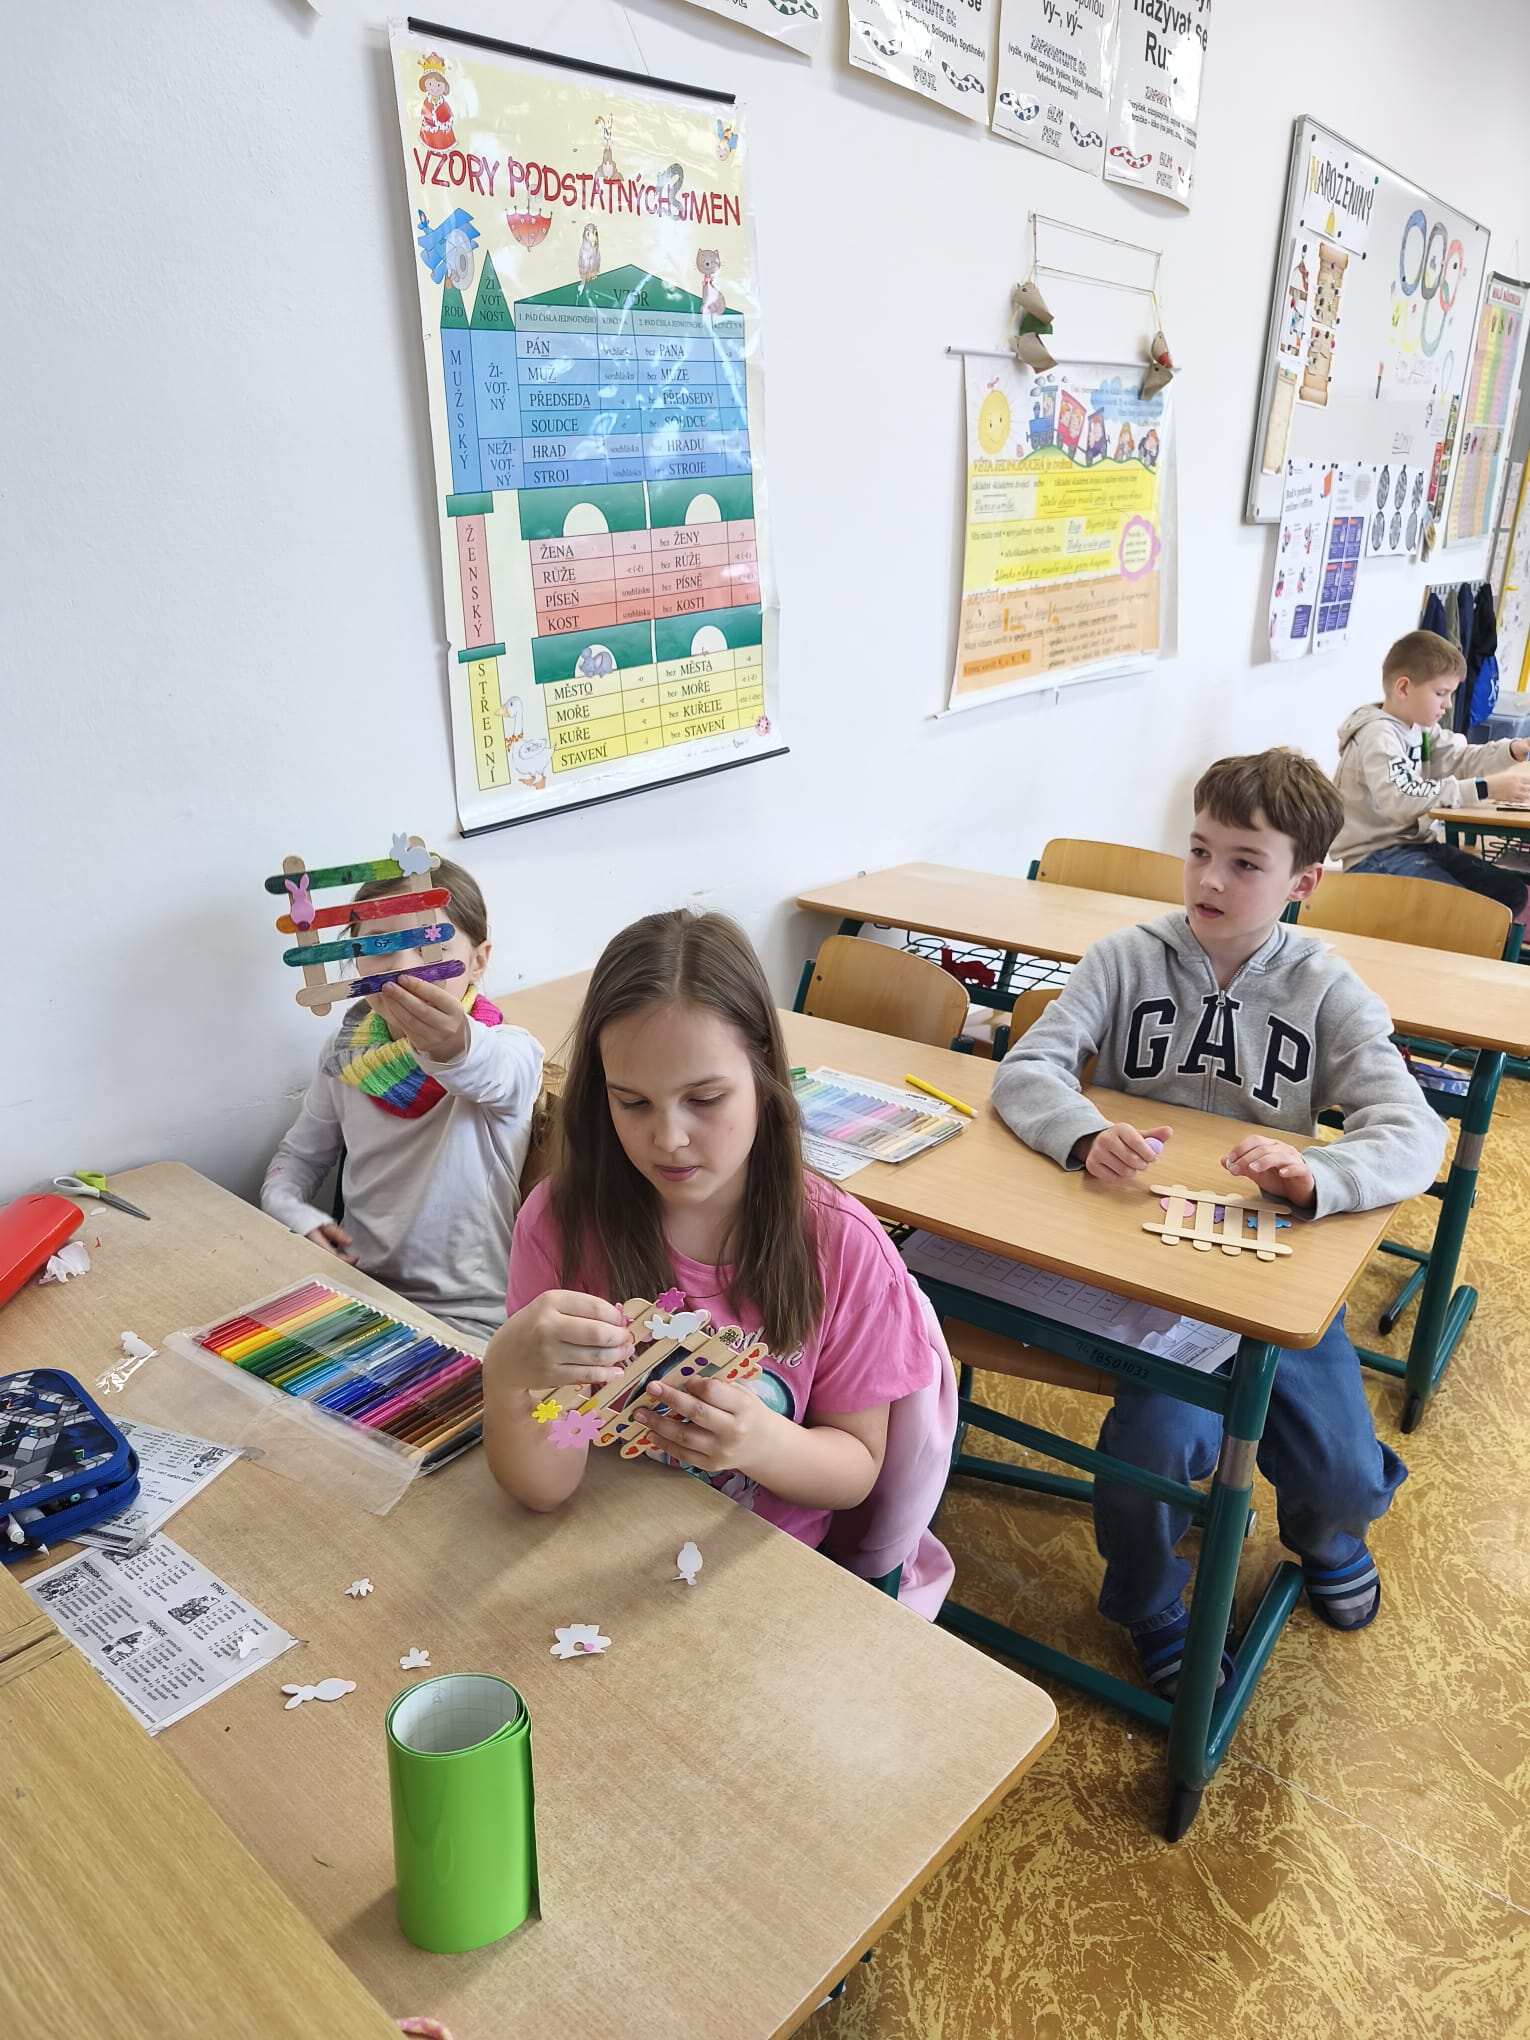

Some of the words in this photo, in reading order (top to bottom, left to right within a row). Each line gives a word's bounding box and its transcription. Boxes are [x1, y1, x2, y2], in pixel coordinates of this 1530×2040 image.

[413, 148, 499, 197] VZORY
[508, 156, 672, 218] PODSTATNÝCH
[679, 190, 742, 226] JMEN
[444, 305, 464, 318] ROD
[526, 336, 551, 355] PÁN
[529, 390, 591, 407] PŘEDSEDA
[531, 419, 579, 433] SOUDCE
[532, 444, 566, 459] HRAD
[667, 438, 704, 453] HRADU
[534, 469, 569, 484] STROJ
[669, 461, 707, 476] STROJE
[673, 531, 700, 546] ŽENY
[540, 543, 575, 560] ŽENA
[545, 589, 579, 608] PÍSEŇ
[676, 596, 705, 612] KOSTI
[548, 615, 580, 632] KOST
[680, 659, 713, 676] MĚSTA
[554, 682, 593, 701] MĚSTO
[681, 680, 711, 697] MOŘE
[556, 701, 590, 722] MOŘE
[683, 698, 723, 718] KUŘETE
[559, 725, 591, 745] KUŘE
[684, 715, 726, 738] STAVENÍ
[561, 743, 607, 767] STAVENÍ
[1122, 993, 1313, 1110] GAP
[211, 1582, 228, 1596] STROJ
